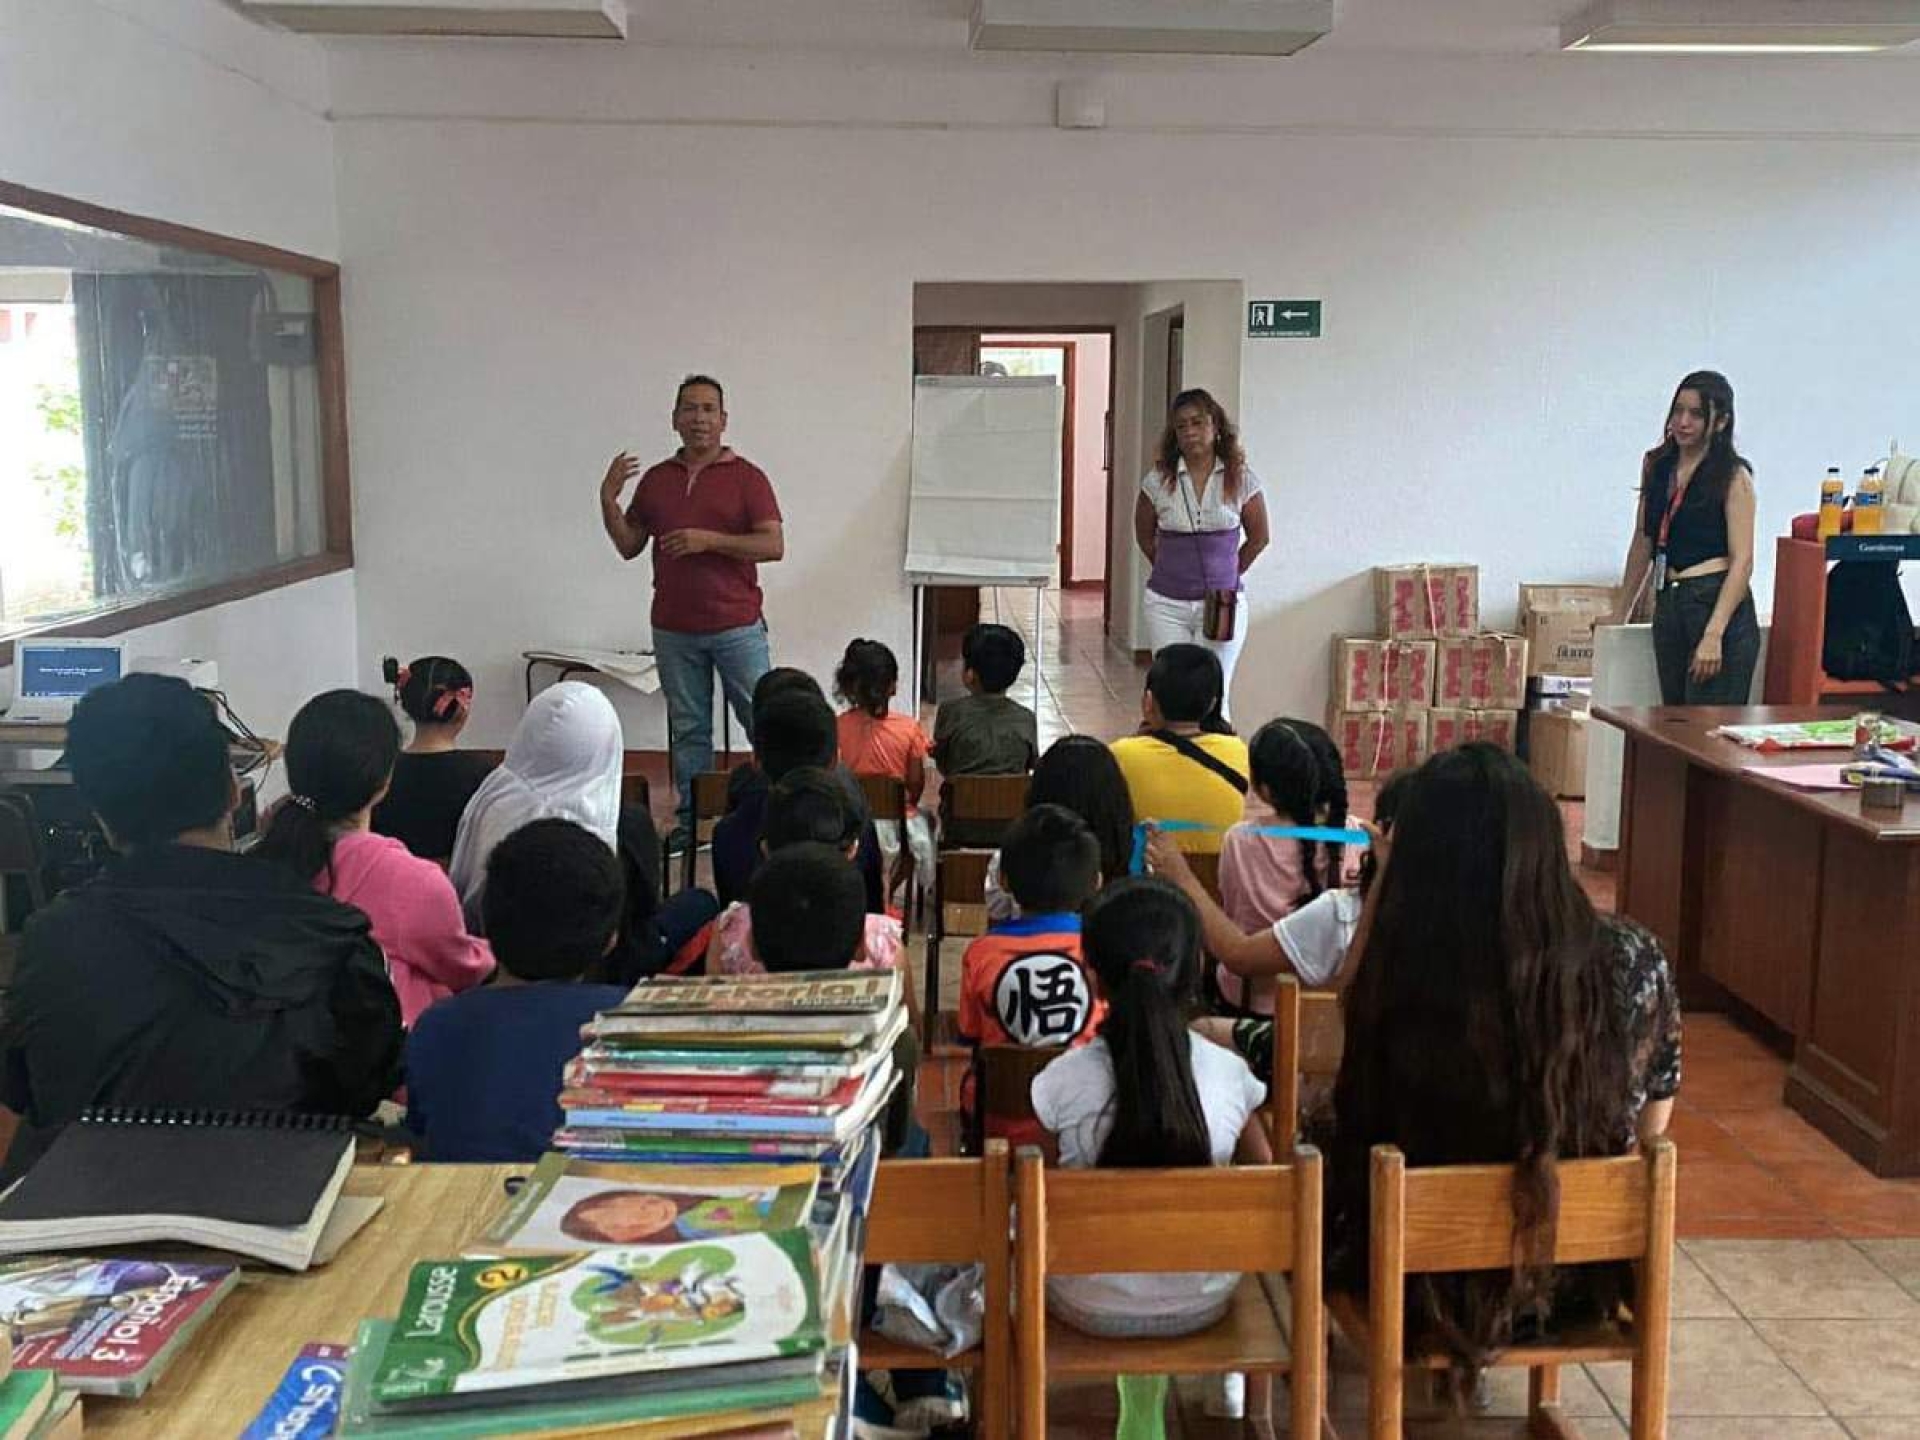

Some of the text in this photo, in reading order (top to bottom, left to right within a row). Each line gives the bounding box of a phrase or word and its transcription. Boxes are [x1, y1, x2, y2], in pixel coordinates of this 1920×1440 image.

[1005, 962, 1083, 1037] 悟
[481, 1268, 523, 1284] 2
[404, 1265, 459, 1338] Larousse
[91, 1348, 126, 1361] 3
